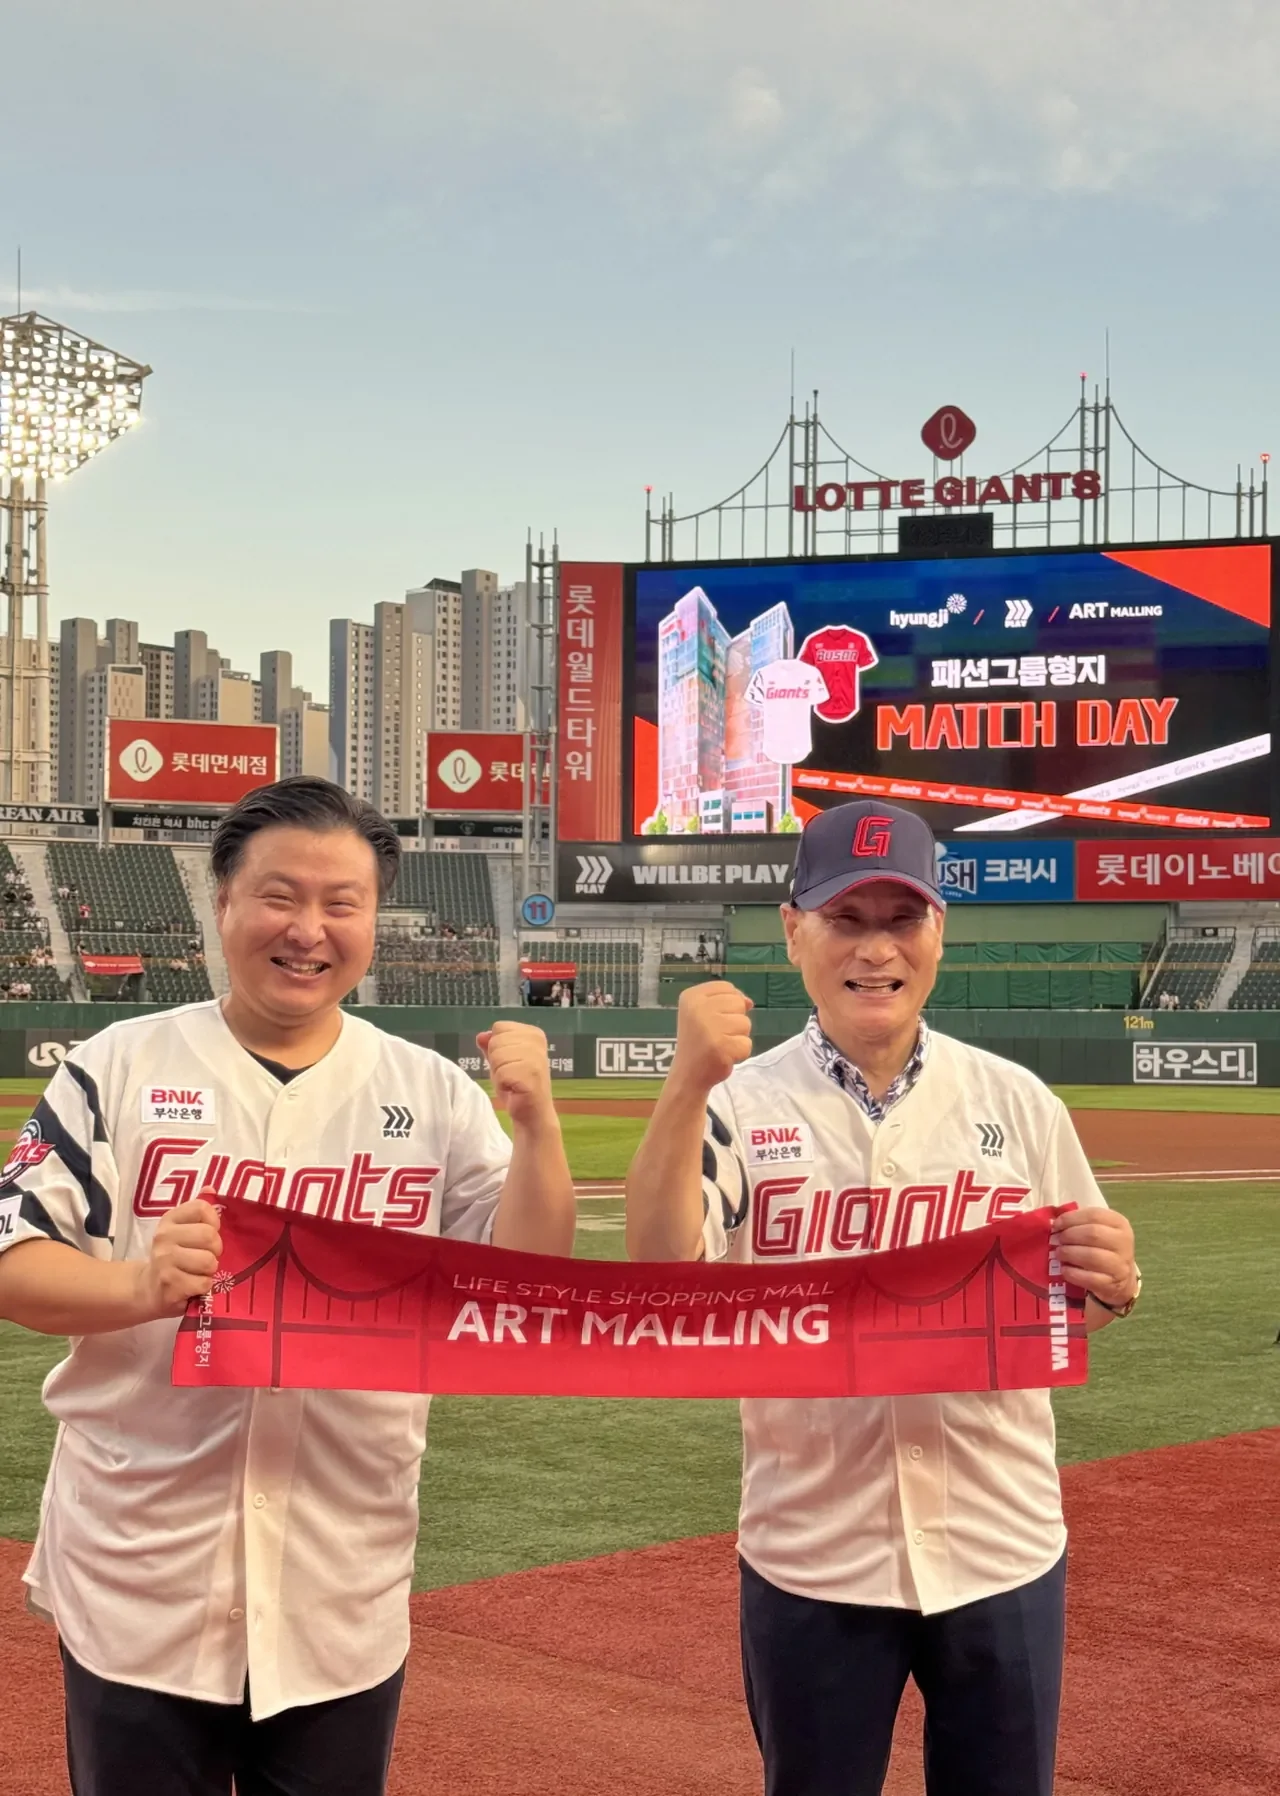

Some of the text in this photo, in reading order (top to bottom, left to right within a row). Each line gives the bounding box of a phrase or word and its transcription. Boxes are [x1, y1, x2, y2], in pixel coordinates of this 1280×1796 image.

[794, 470, 1101, 512] LOTTE GIANTS
[890, 609, 949, 629] hyungji
[1069, 602, 1163, 619] ART MALLING
[931, 655, 1106, 688] 패션그룹형지
[564, 585, 596, 781] 롯데월드타워
[766, 686, 810, 700] Giants
[877, 698, 1179, 750] MATCH DAY
[171, 752, 267, 775] 롯데면세점
[45, 808, 86, 824] AIR
[187, 816, 209, 829] bhc
[852, 815, 895, 858] G
[631, 864, 789, 885] WILLBE PLAY
[984, 858, 1057, 884] 크러시
[575, 884, 606, 894] PLAY
[528, 901, 547, 920] 11
[1124, 1015, 1154, 1029] 121m
[458, 1057, 481, 1072] 양정
[151, 1089, 204, 1105] BNK
[153, 1107, 203, 1121] 부산은행
[383, 1130, 411, 1138] PLAY
[751, 1127, 803, 1146] BNK
[755, 1147, 802, 1161] 부산은행
[981, 1148, 1002, 1158] PLAY
[133, 1137, 442, 1229] Giants
[453, 1274, 834, 1307] LIFE STYLE SHOPPING MALL
[446, 1301, 830, 1346] ART MALLING
[1048, 1282, 1070, 1371] WILLBE
